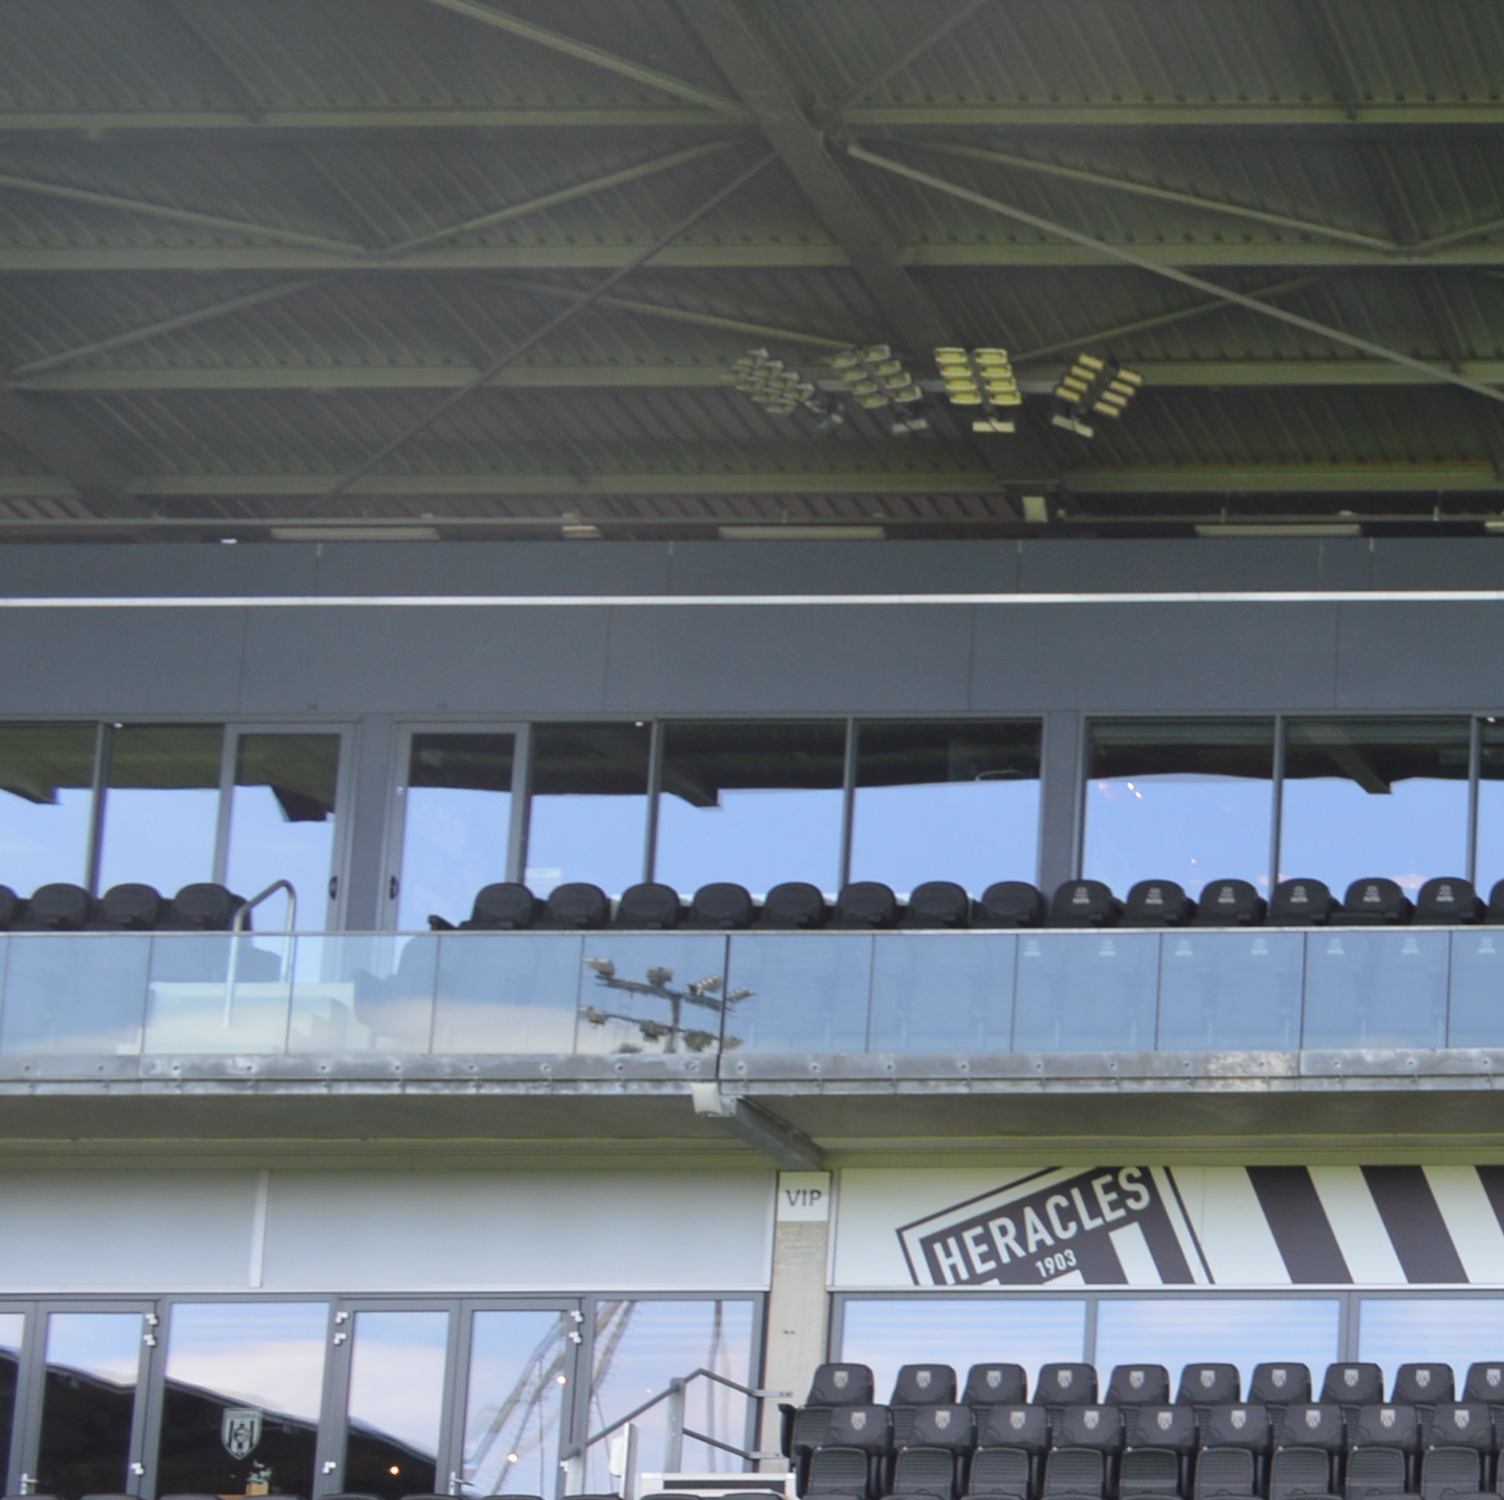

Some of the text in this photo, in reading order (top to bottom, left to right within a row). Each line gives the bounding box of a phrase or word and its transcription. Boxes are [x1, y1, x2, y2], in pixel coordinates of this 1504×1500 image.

[786, 1190, 822, 1207] VIP
[932, 1166, 1152, 1284] HERACLES
[1035, 1249, 1077, 1278] 1903
